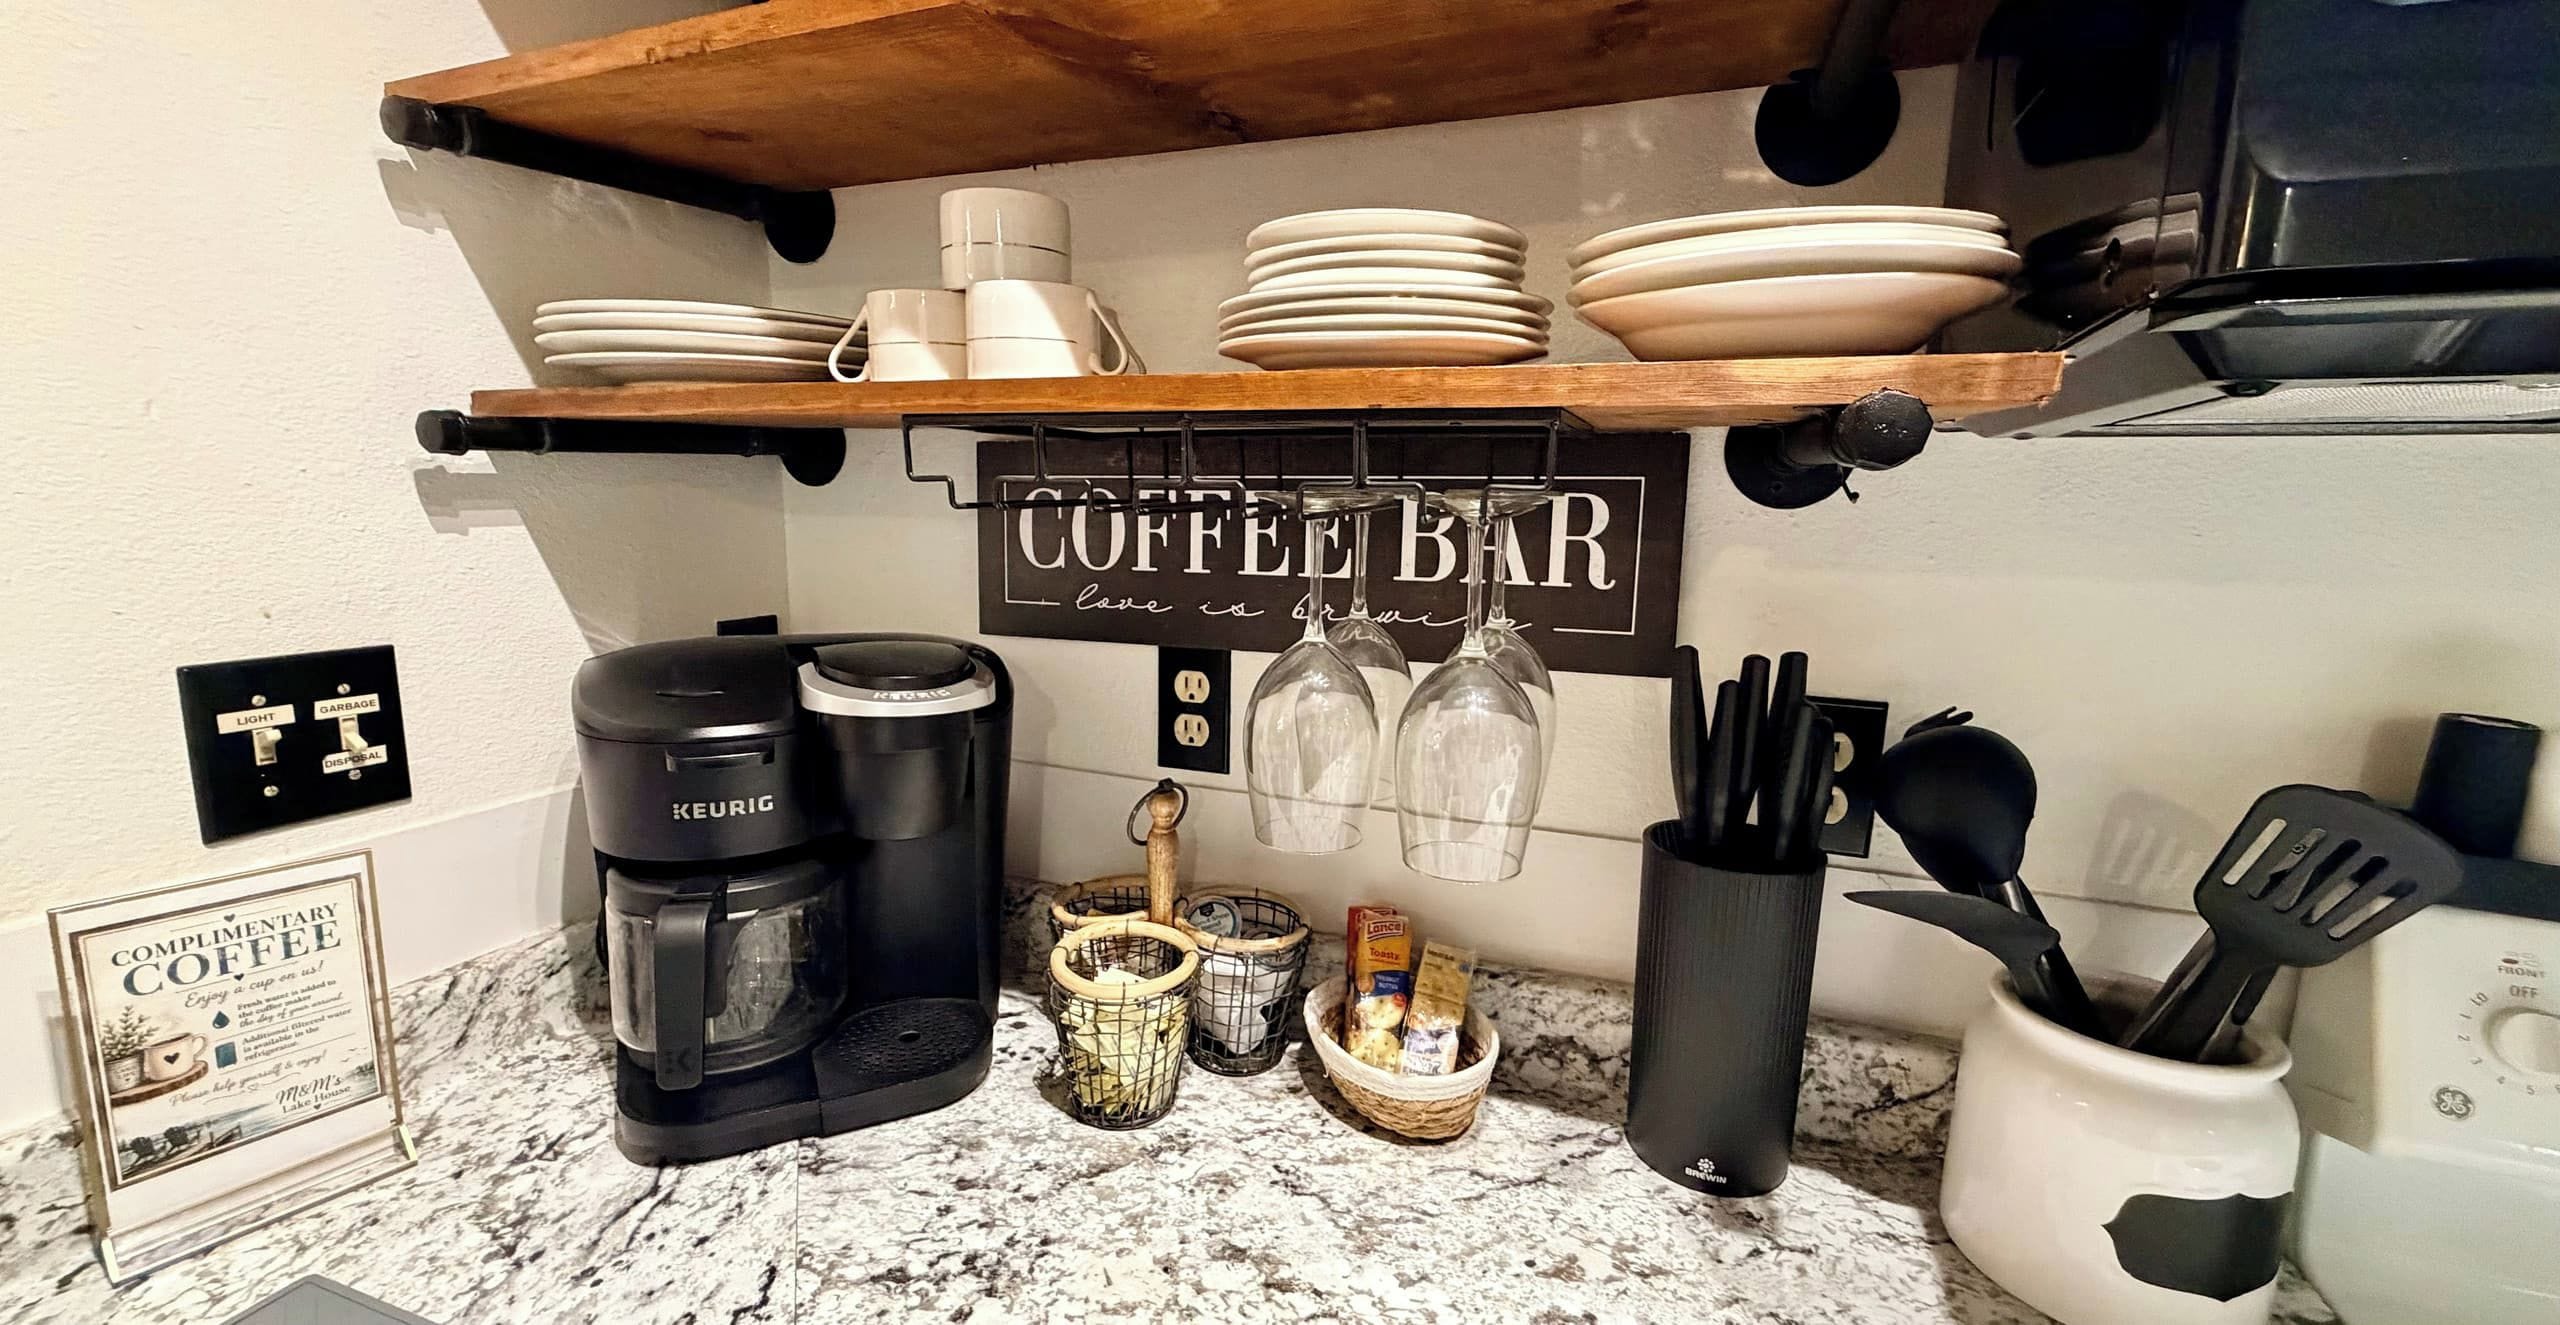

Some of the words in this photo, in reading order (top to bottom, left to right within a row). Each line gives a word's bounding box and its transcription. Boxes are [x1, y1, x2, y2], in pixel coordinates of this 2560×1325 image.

[1019, 487, 1352, 579] COFFEE
[1393, 492, 1616, 590] BAR
[1076, 583, 1172, 613] love
[1200, 601, 1264, 617] is
[237, 712, 276, 726] LIGHT
[320, 699, 377, 714] GARBAGE
[324, 751, 382, 769] DISPOSAL
[673, 795, 773, 820] KEURIG
[111, 903, 338, 967] COMPLIMENTARY
[1367, 922, 1401, 935] Lance
[123, 920, 341, 996] COFFEE
[1369, 946, 1400, 960] Toasty
[2498, 965, 2545, 978] FRONT
[185, 990, 228, 1009] Enjoy
[234, 985, 244, 994] a
[250, 977, 275, 991] cup
[279, 972, 295, 982] on
[301, 960, 324, 976] us!
[237, 999, 263, 1010] Fresh
[264, 992, 289, 1002] water
[300, 981, 326, 993] added
[2509, 984, 2539, 998] OFF
[238, 1010, 253, 1019] the
[256, 1003, 282, 1014] coffee
[284, 995, 311, 1006] maker
[240, 1018, 254, 1027] the
[257, 1014, 274, 1023] day
[277, 1007, 287, 1019] of
[243, 1026, 289, 1045] Additional
[291, 1015, 326, 1030] filtered
[327, 1009, 352, 1019] water
[253, 1034, 292, 1050] available
[305, 1026, 319, 1034] the
[169, 1089, 209, 1106] Please
[213, 1078, 237, 1092] help
[240, 1062, 282, 1087] yourself
[284, 1059, 293, 1069] &
[276, 1074, 342, 1105] M&M's
[282, 1100, 311, 1113] Lake
[315, 1086, 352, 1102] House
